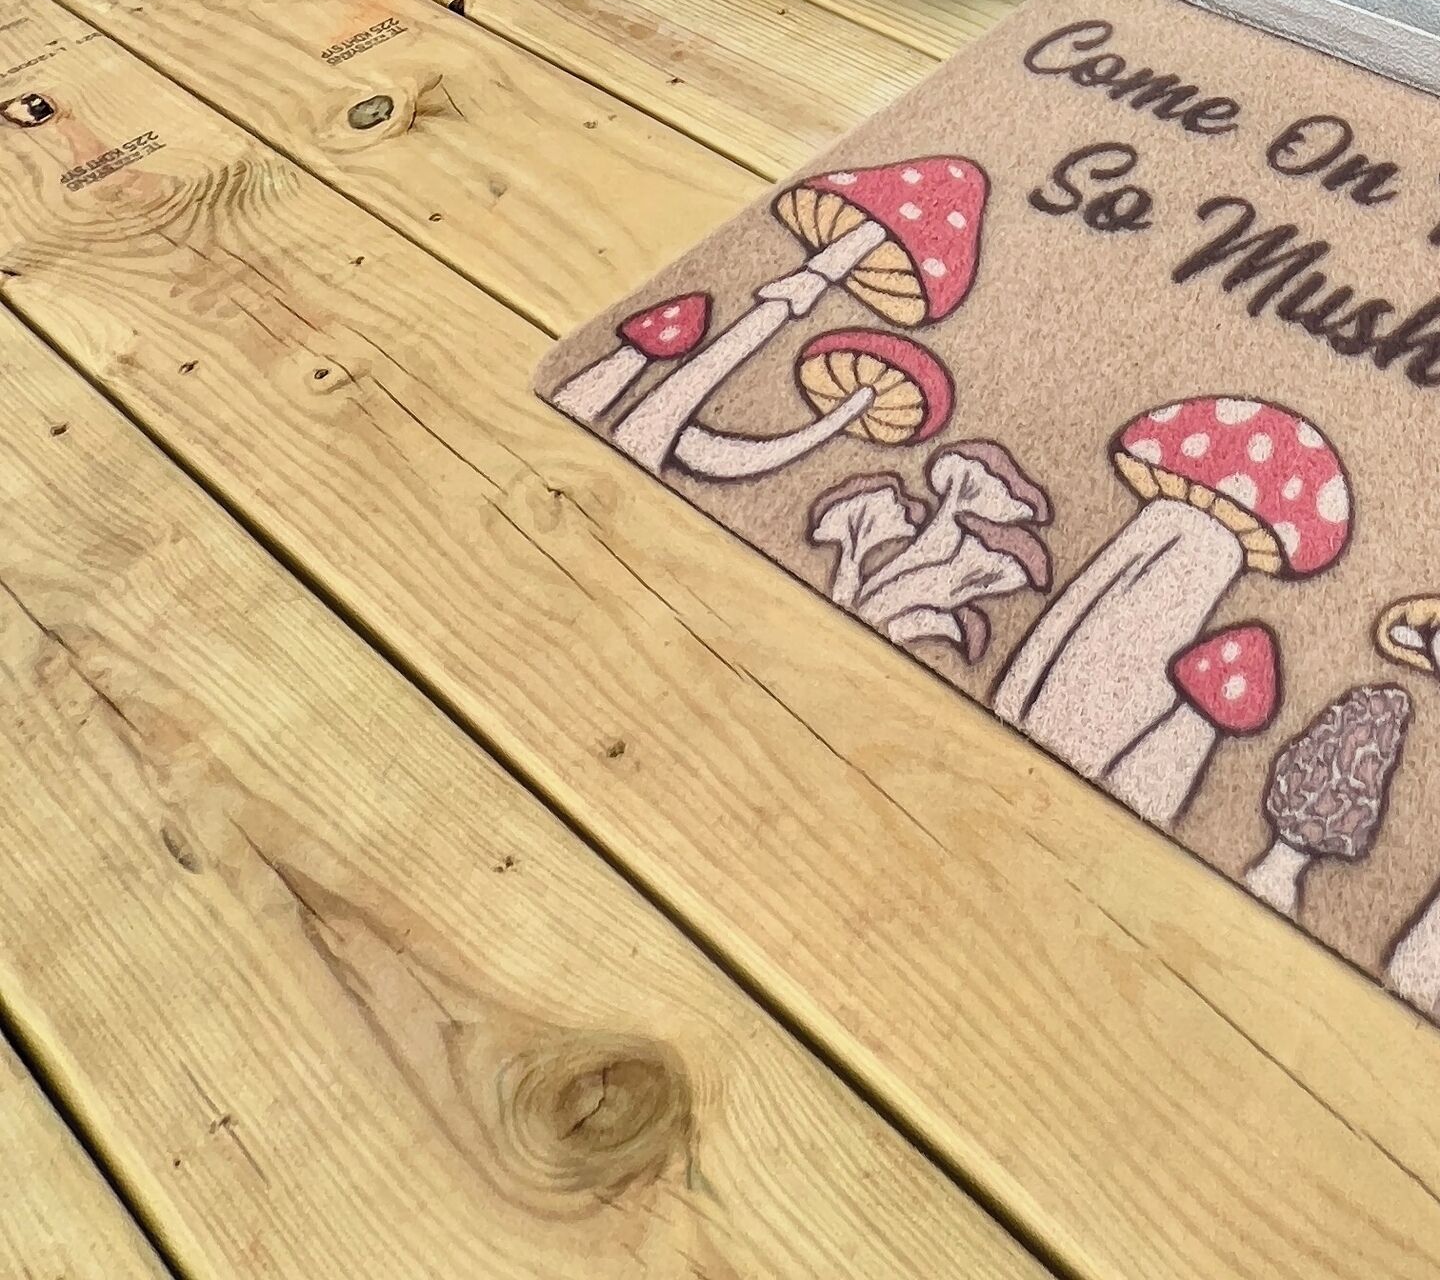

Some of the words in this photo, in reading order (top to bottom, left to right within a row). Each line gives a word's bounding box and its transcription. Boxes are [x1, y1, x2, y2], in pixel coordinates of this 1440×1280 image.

[122, 130, 159, 153] 225
[1024, 17, 1238, 136] Come
[1265, 112, 1401, 209] On
[1027, 140, 1154, 235] So
